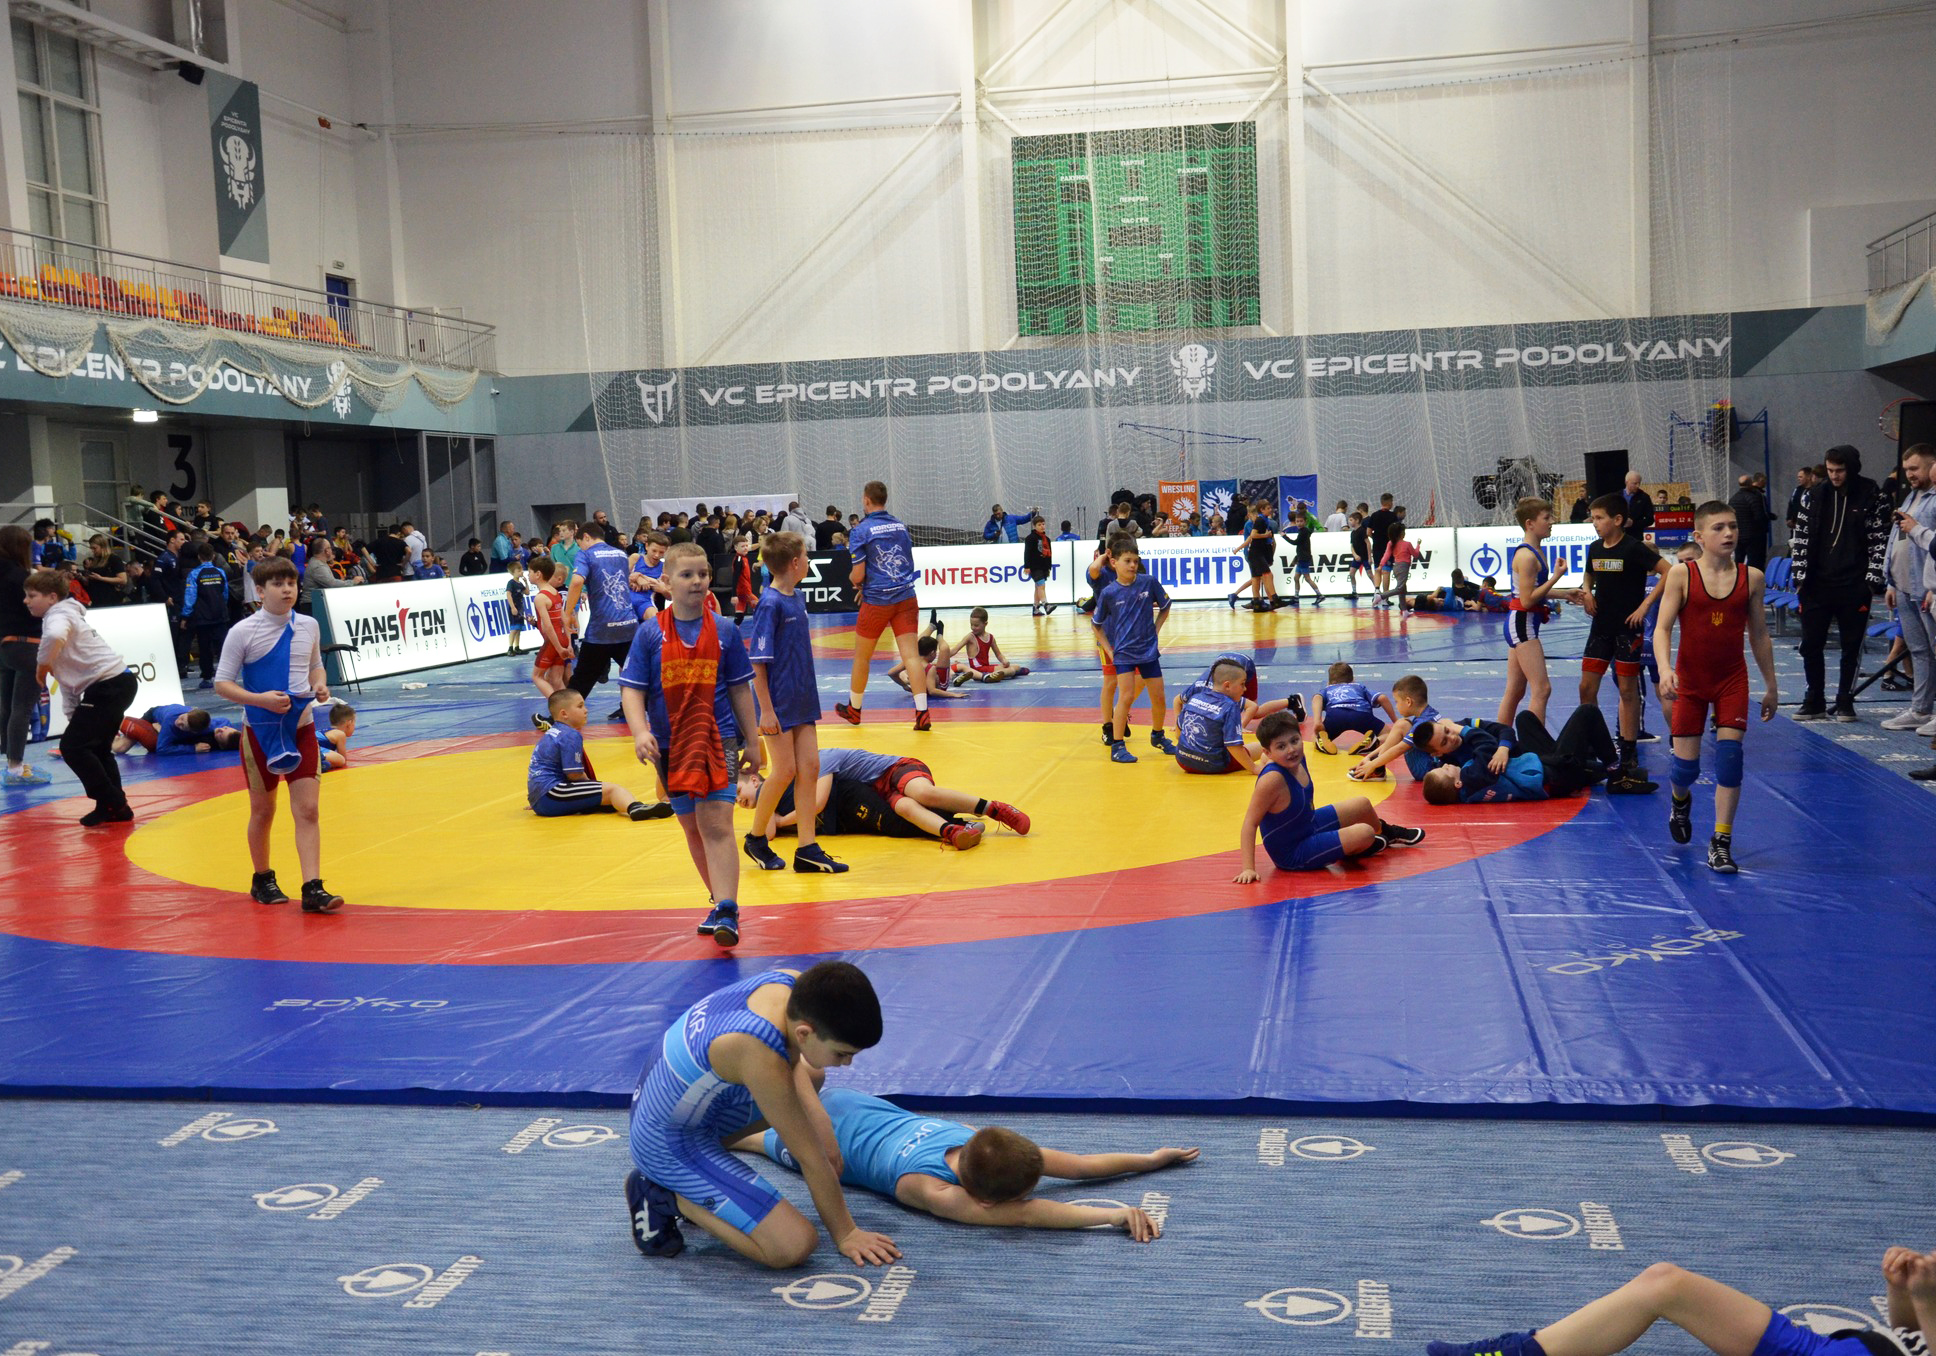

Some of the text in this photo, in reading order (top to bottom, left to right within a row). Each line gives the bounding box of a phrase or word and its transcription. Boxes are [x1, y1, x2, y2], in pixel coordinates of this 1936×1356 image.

[1242, 336, 1732, 380] VC EPICENTR PODOLYANY
[699, 366, 1143, 407] VC EPICENTR PODOLYANY
[167, 433, 196, 502] 3
[1161, 484, 1196, 493] WRESLING
[1541, 535, 1598, 543] ТОРГОВЕЛЬНИ
[924, 563, 1061, 587] INTERSPOT
[357, 637, 448, 662] SINCE 1993
[689, 993, 715, 1040] UKR
[897, 1122, 943, 1157] UKR
